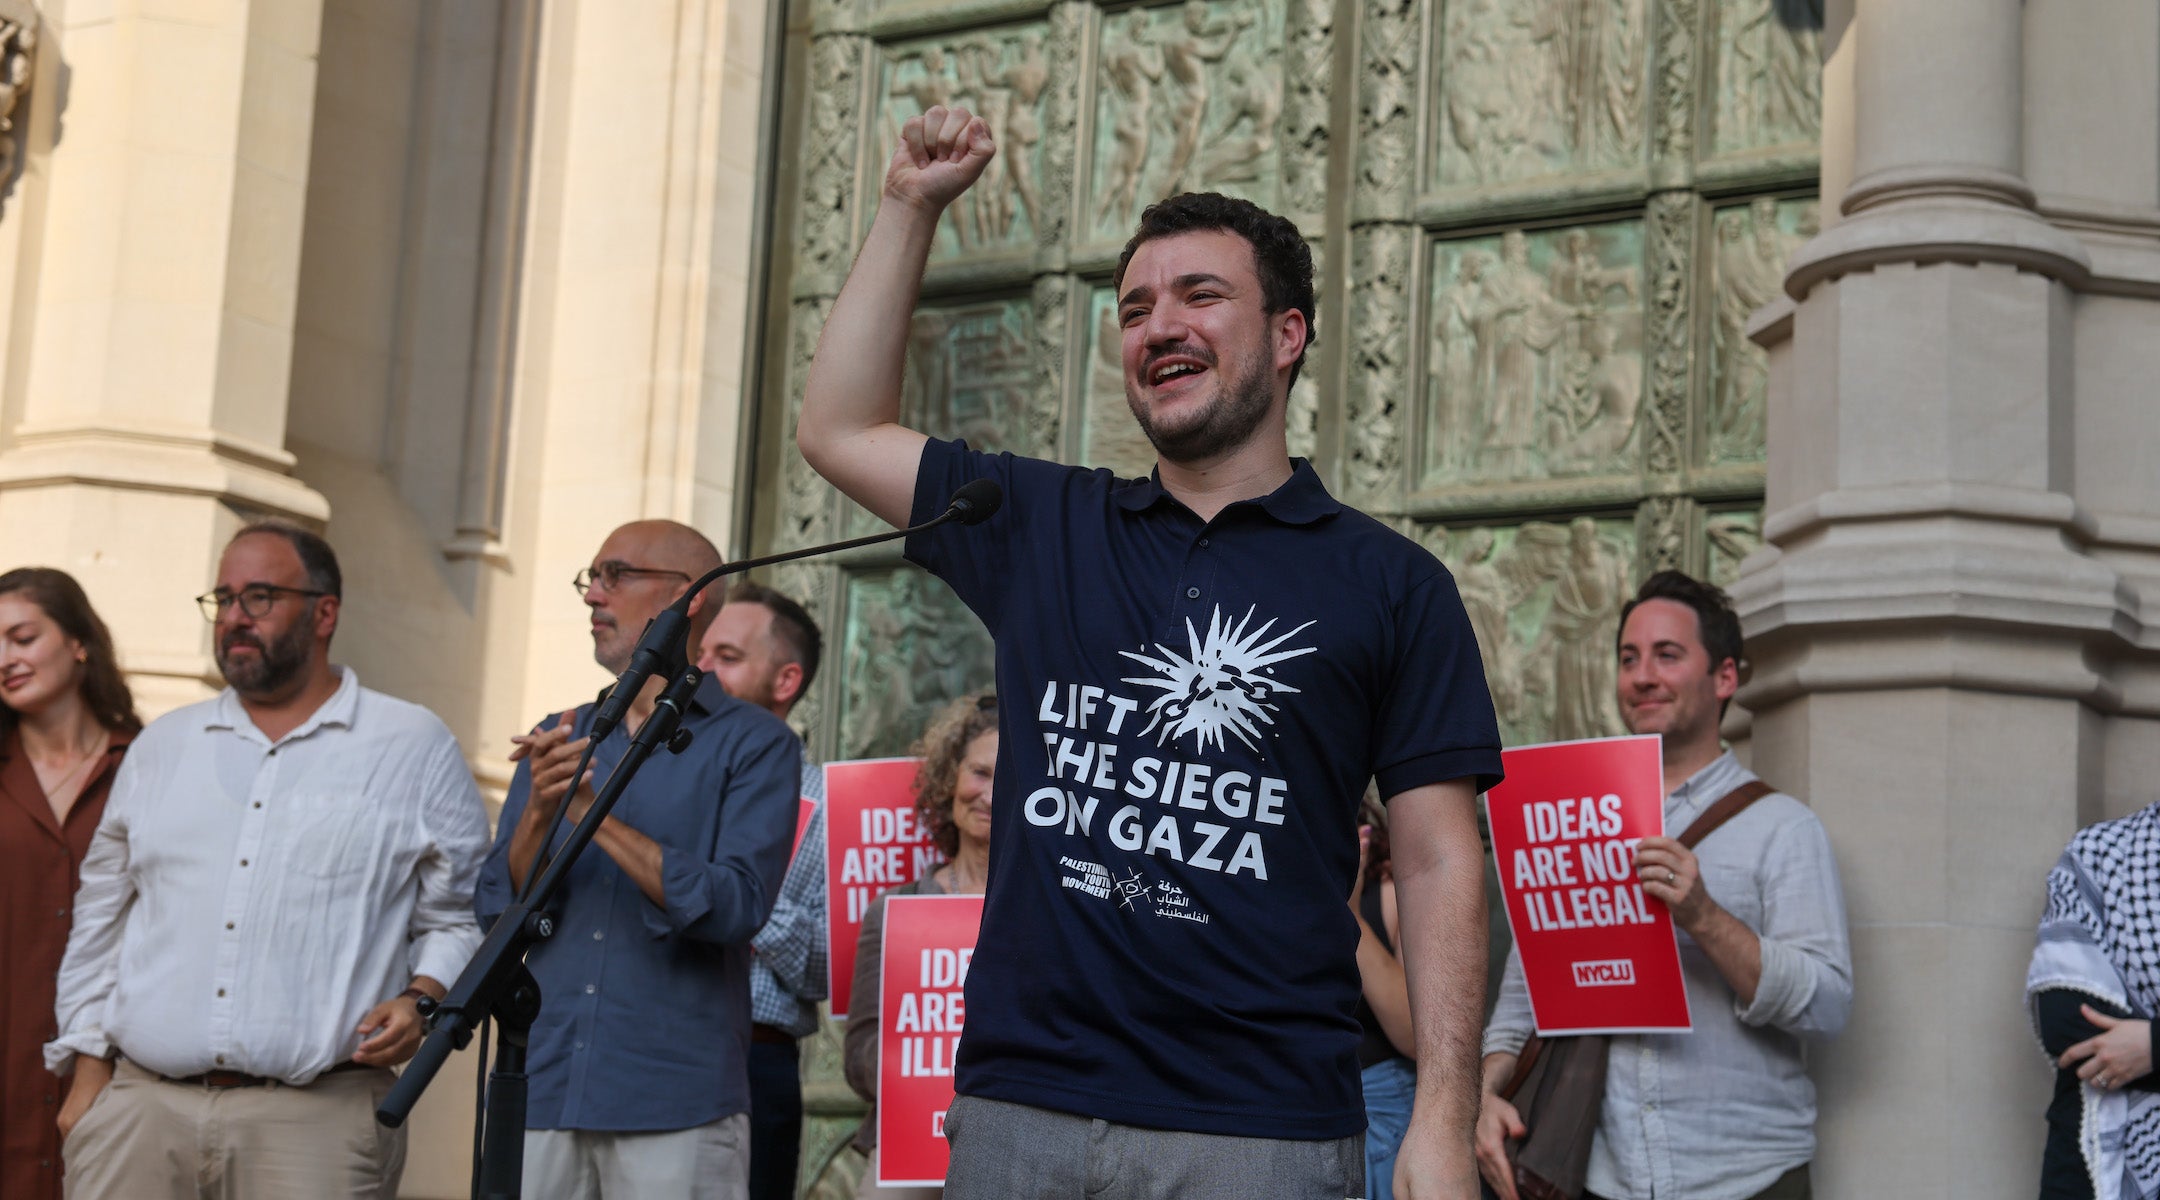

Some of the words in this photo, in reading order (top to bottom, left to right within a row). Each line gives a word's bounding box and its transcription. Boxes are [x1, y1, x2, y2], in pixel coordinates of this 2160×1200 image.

[1039, 681, 1138, 735] LIFT
[1043, 732, 1118, 790] THE
[1124, 757, 1288, 826] SIEGE
[1024, 787, 1100, 837] ON
[1108, 805, 1268, 881] GAZA
[1522, 794, 1623, 843] IDEAS
[841, 847, 905, 883] ARE
[1514, 845, 1577, 889] ARE
[1062, 876, 1111, 900] MOVEMENT
[1156, 893, 1189, 907] الشباب
[1158, 880, 1183, 894] حركة
[1155, 906, 1209, 924] الفلسطيني
[1524, 884, 1655, 932] ILLEGAL
[1576, 963, 1631, 983] NYCLU
[896, 992, 965, 1032] ARE
